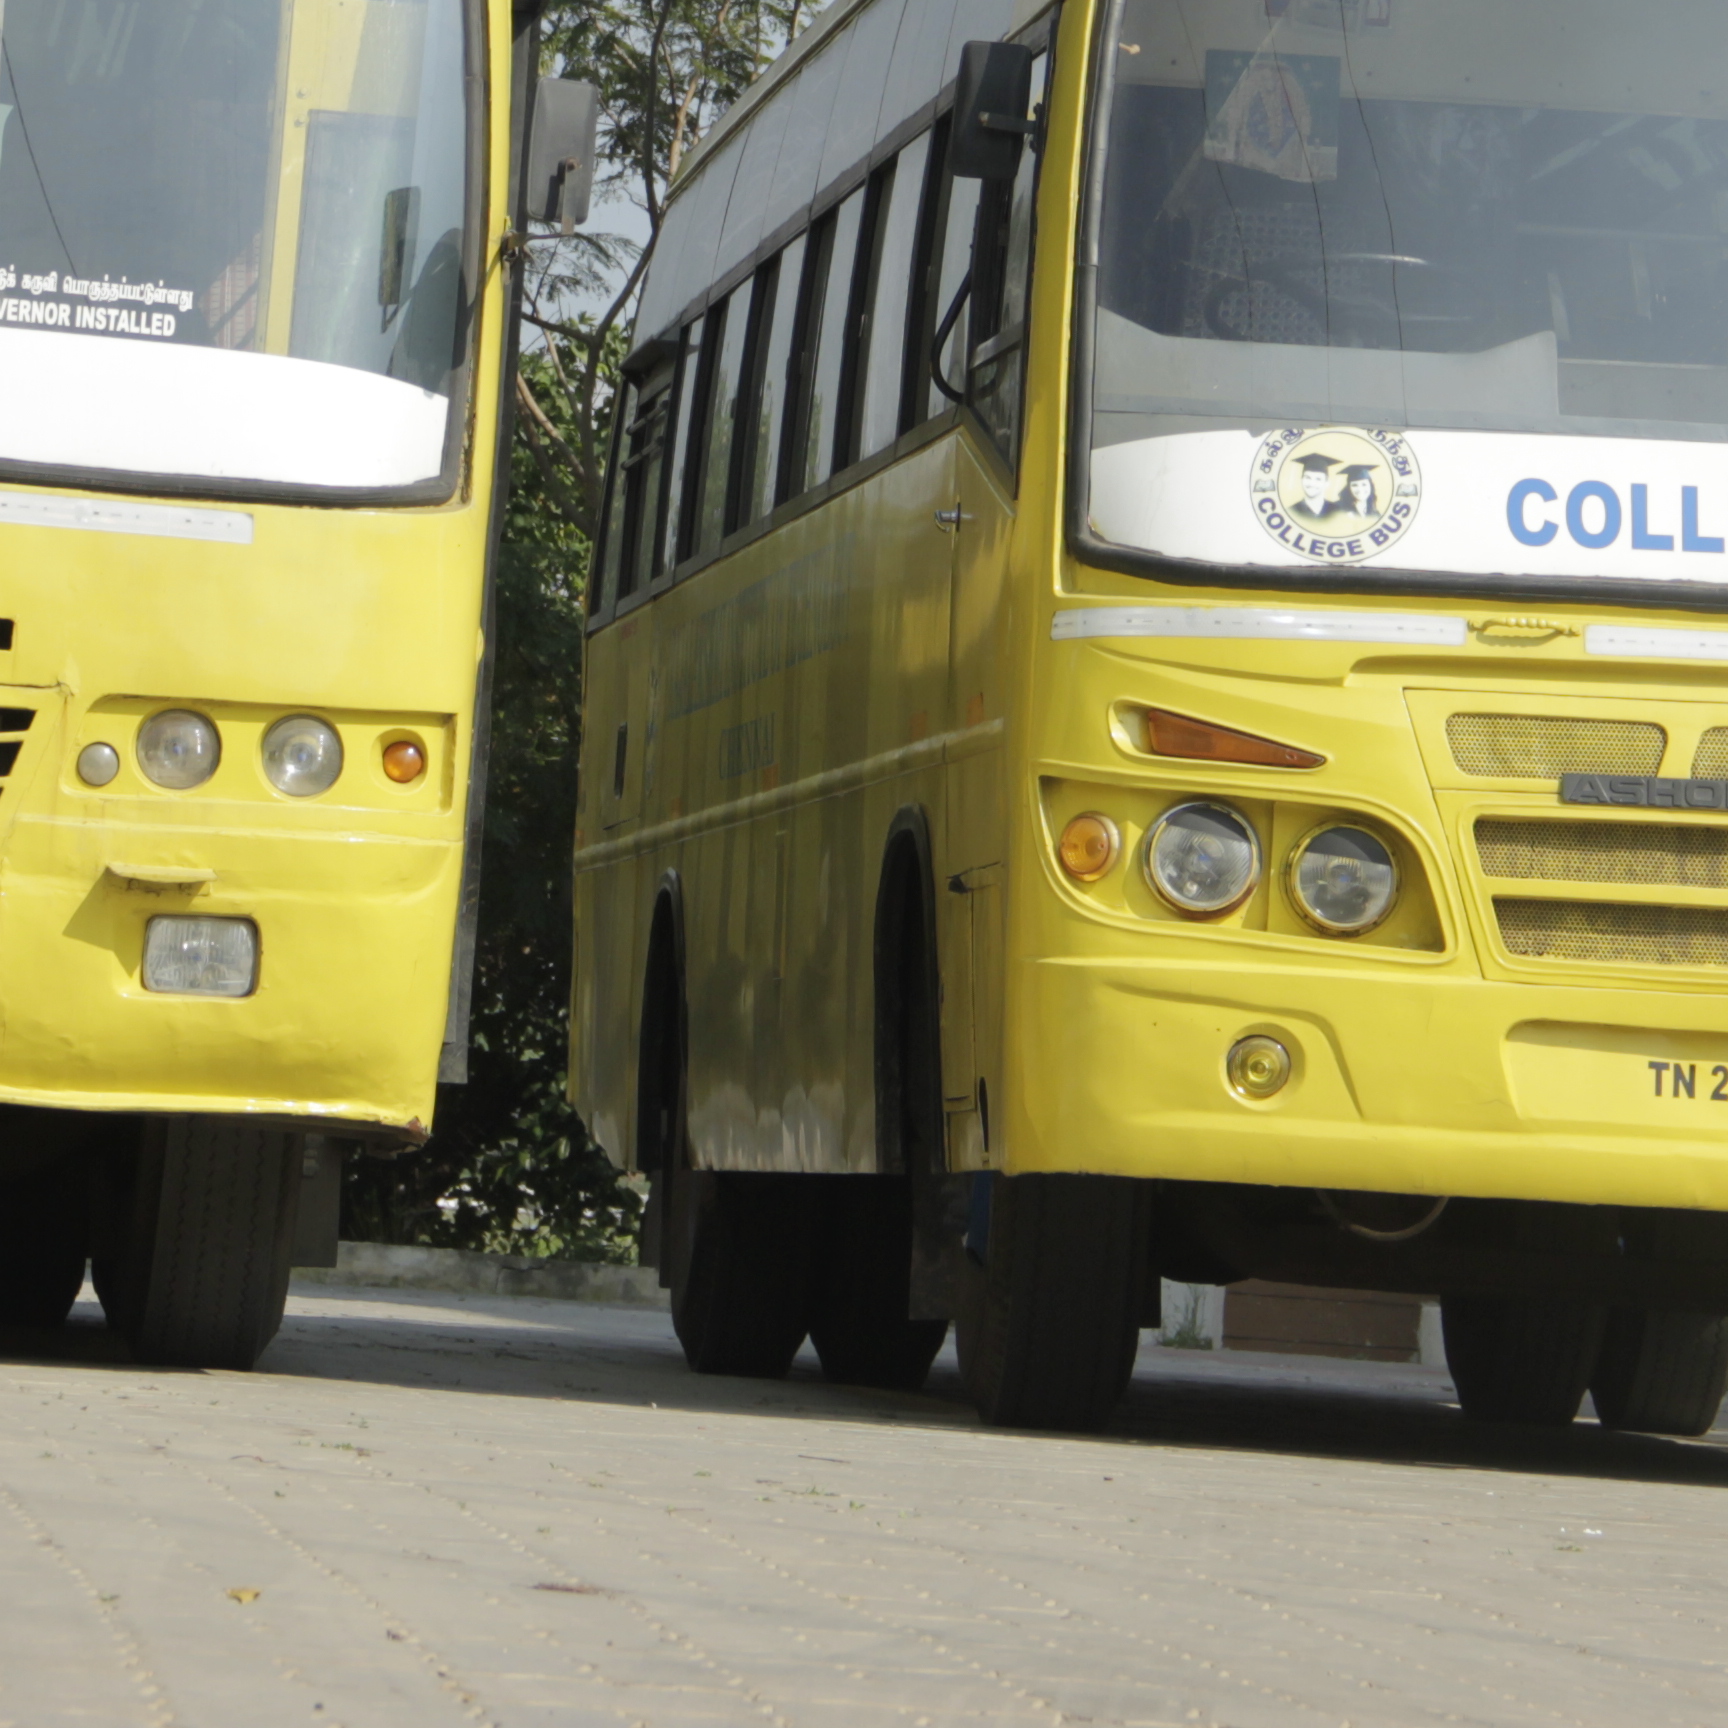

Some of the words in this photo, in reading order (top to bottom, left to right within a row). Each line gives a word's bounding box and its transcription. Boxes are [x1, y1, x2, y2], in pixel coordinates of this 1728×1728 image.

[21, 270, 58, 295] கருவி
[75, 305, 176, 337] INSTALLED
[1257, 497, 1365, 558] COLLEGE
[1368, 501, 1412, 547] BUS
[1647, 1060, 1697, 1101] TN
